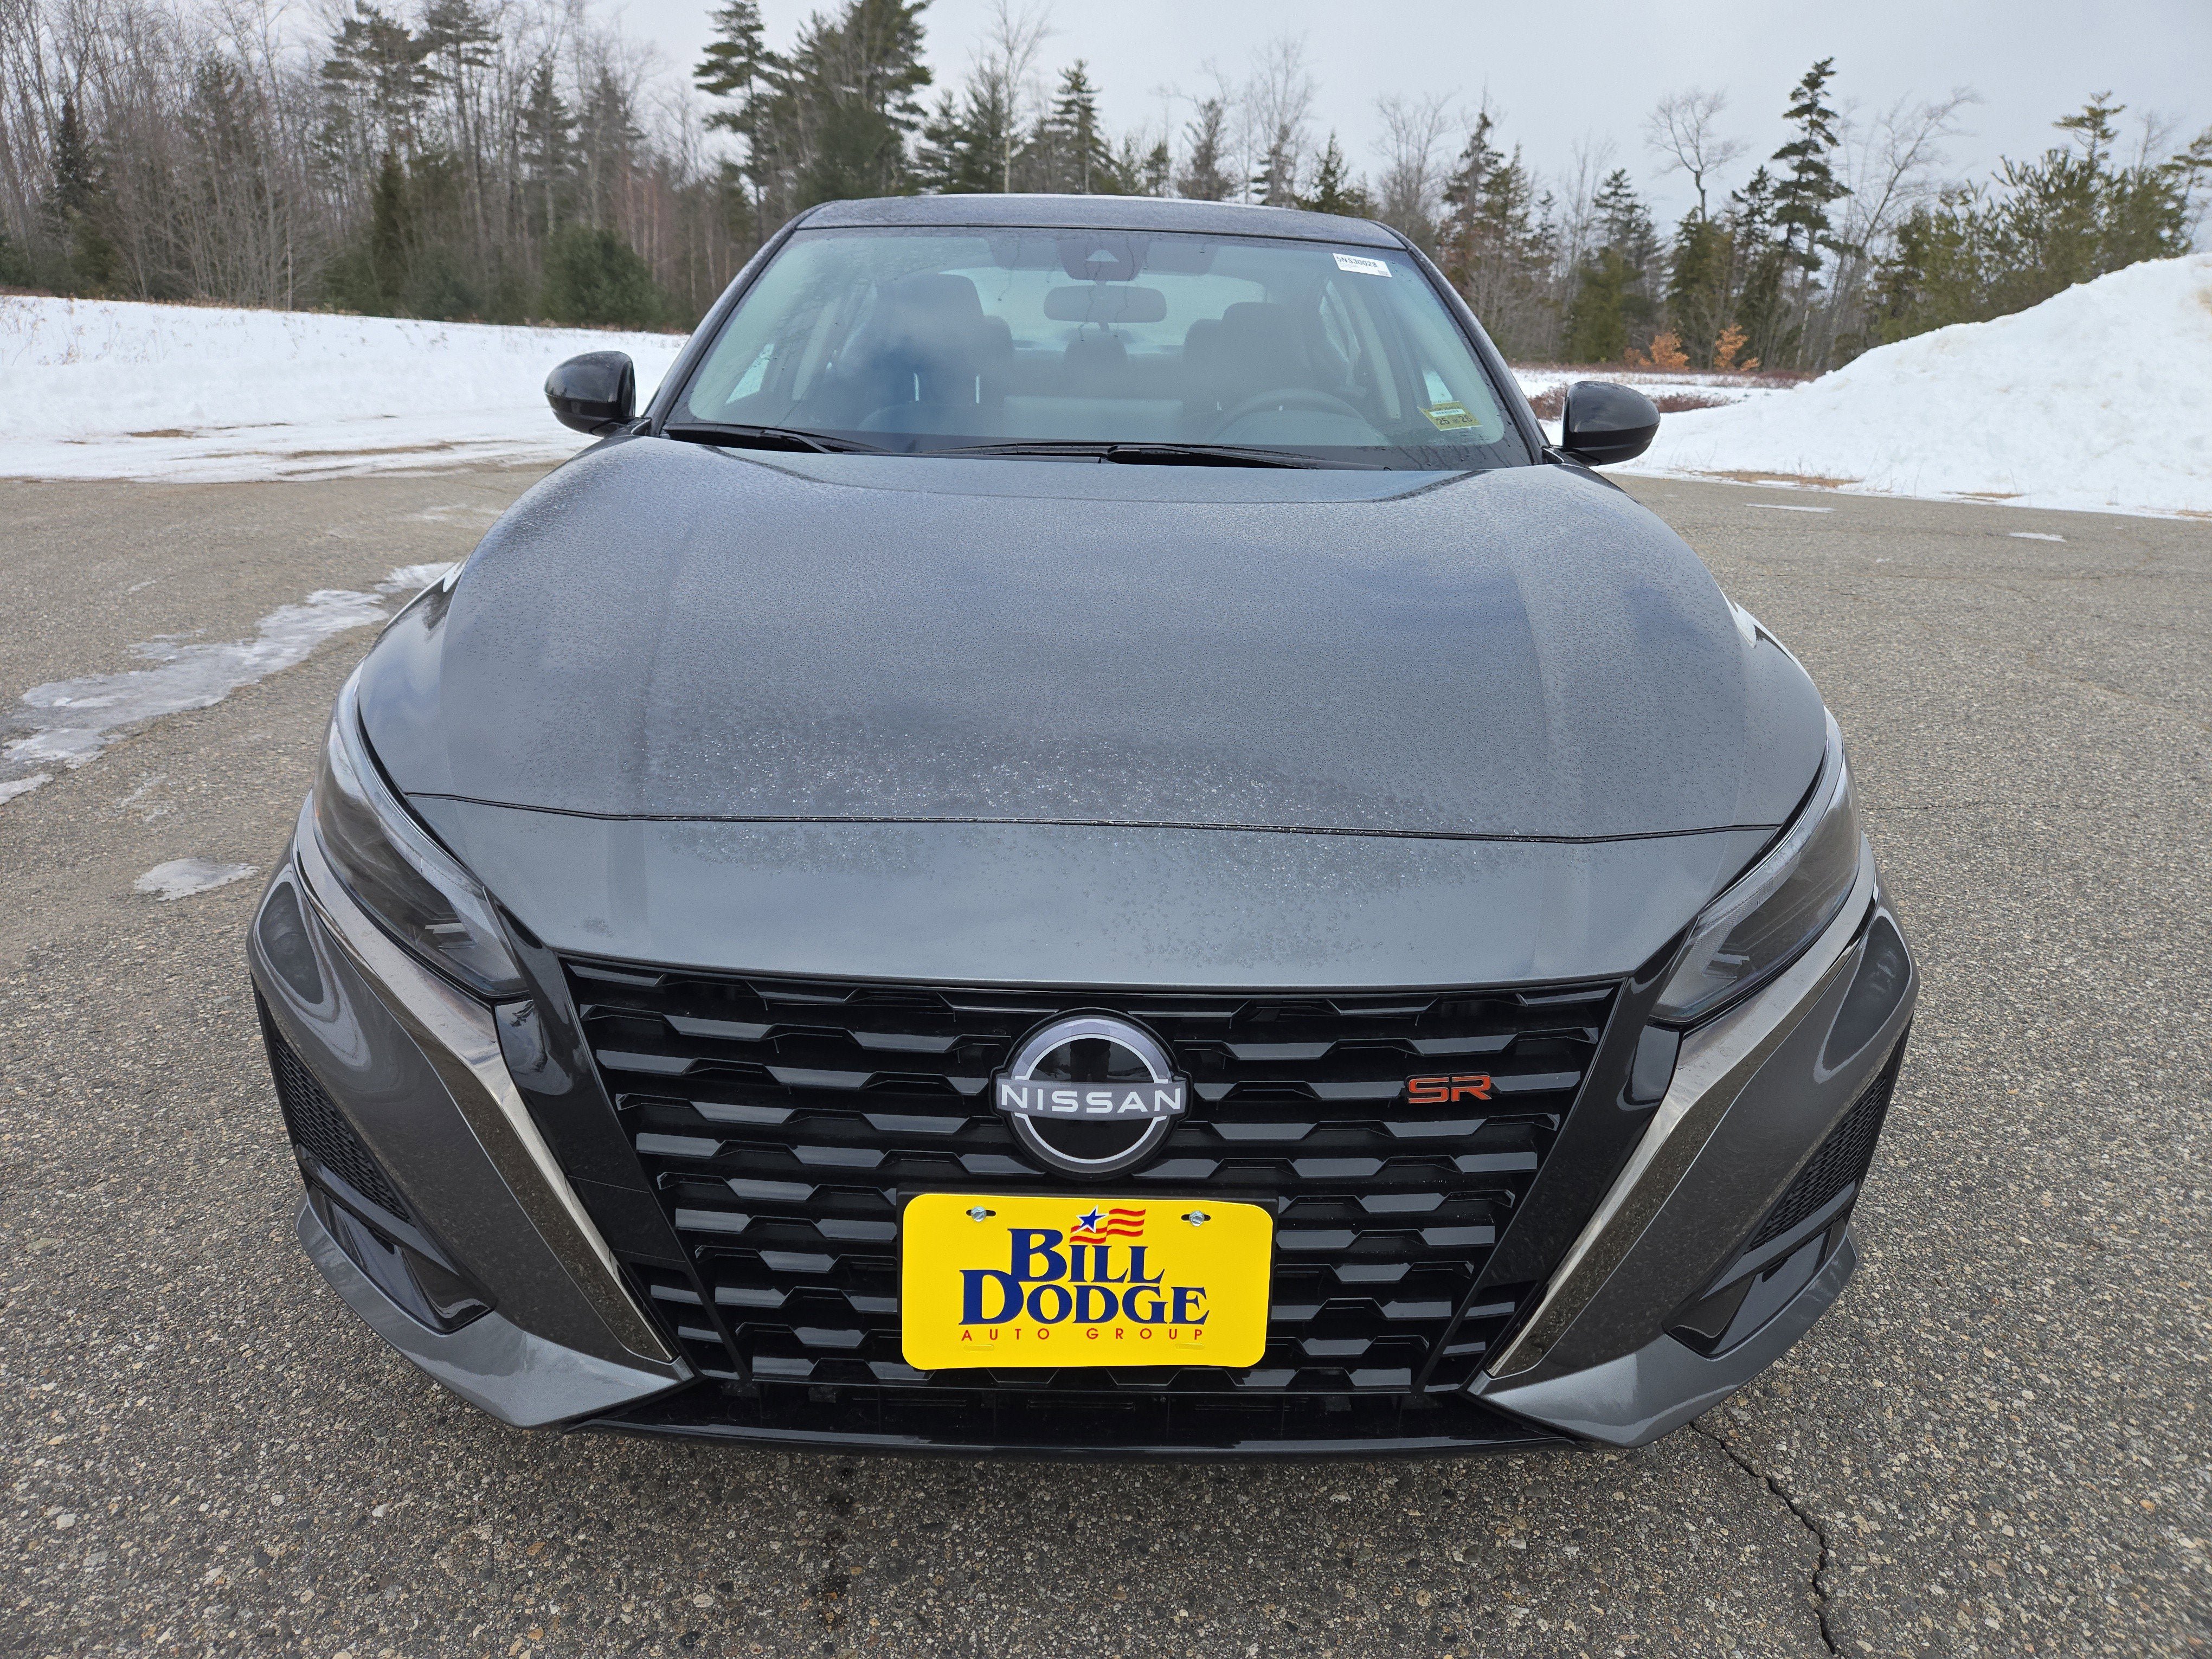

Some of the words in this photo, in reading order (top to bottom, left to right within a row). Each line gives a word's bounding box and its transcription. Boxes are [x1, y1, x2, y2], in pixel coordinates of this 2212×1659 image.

[1001, 1084, 1181, 1114] NISSAN
[1409, 1075, 1492, 1104] SR
[1007, 1228, 1165, 1284] BILL
[959, 1269, 1210, 1326] DODGE
[961, 1329, 1050, 1342] AUTO
[1086, 1328, 1203, 1341] GROUP
